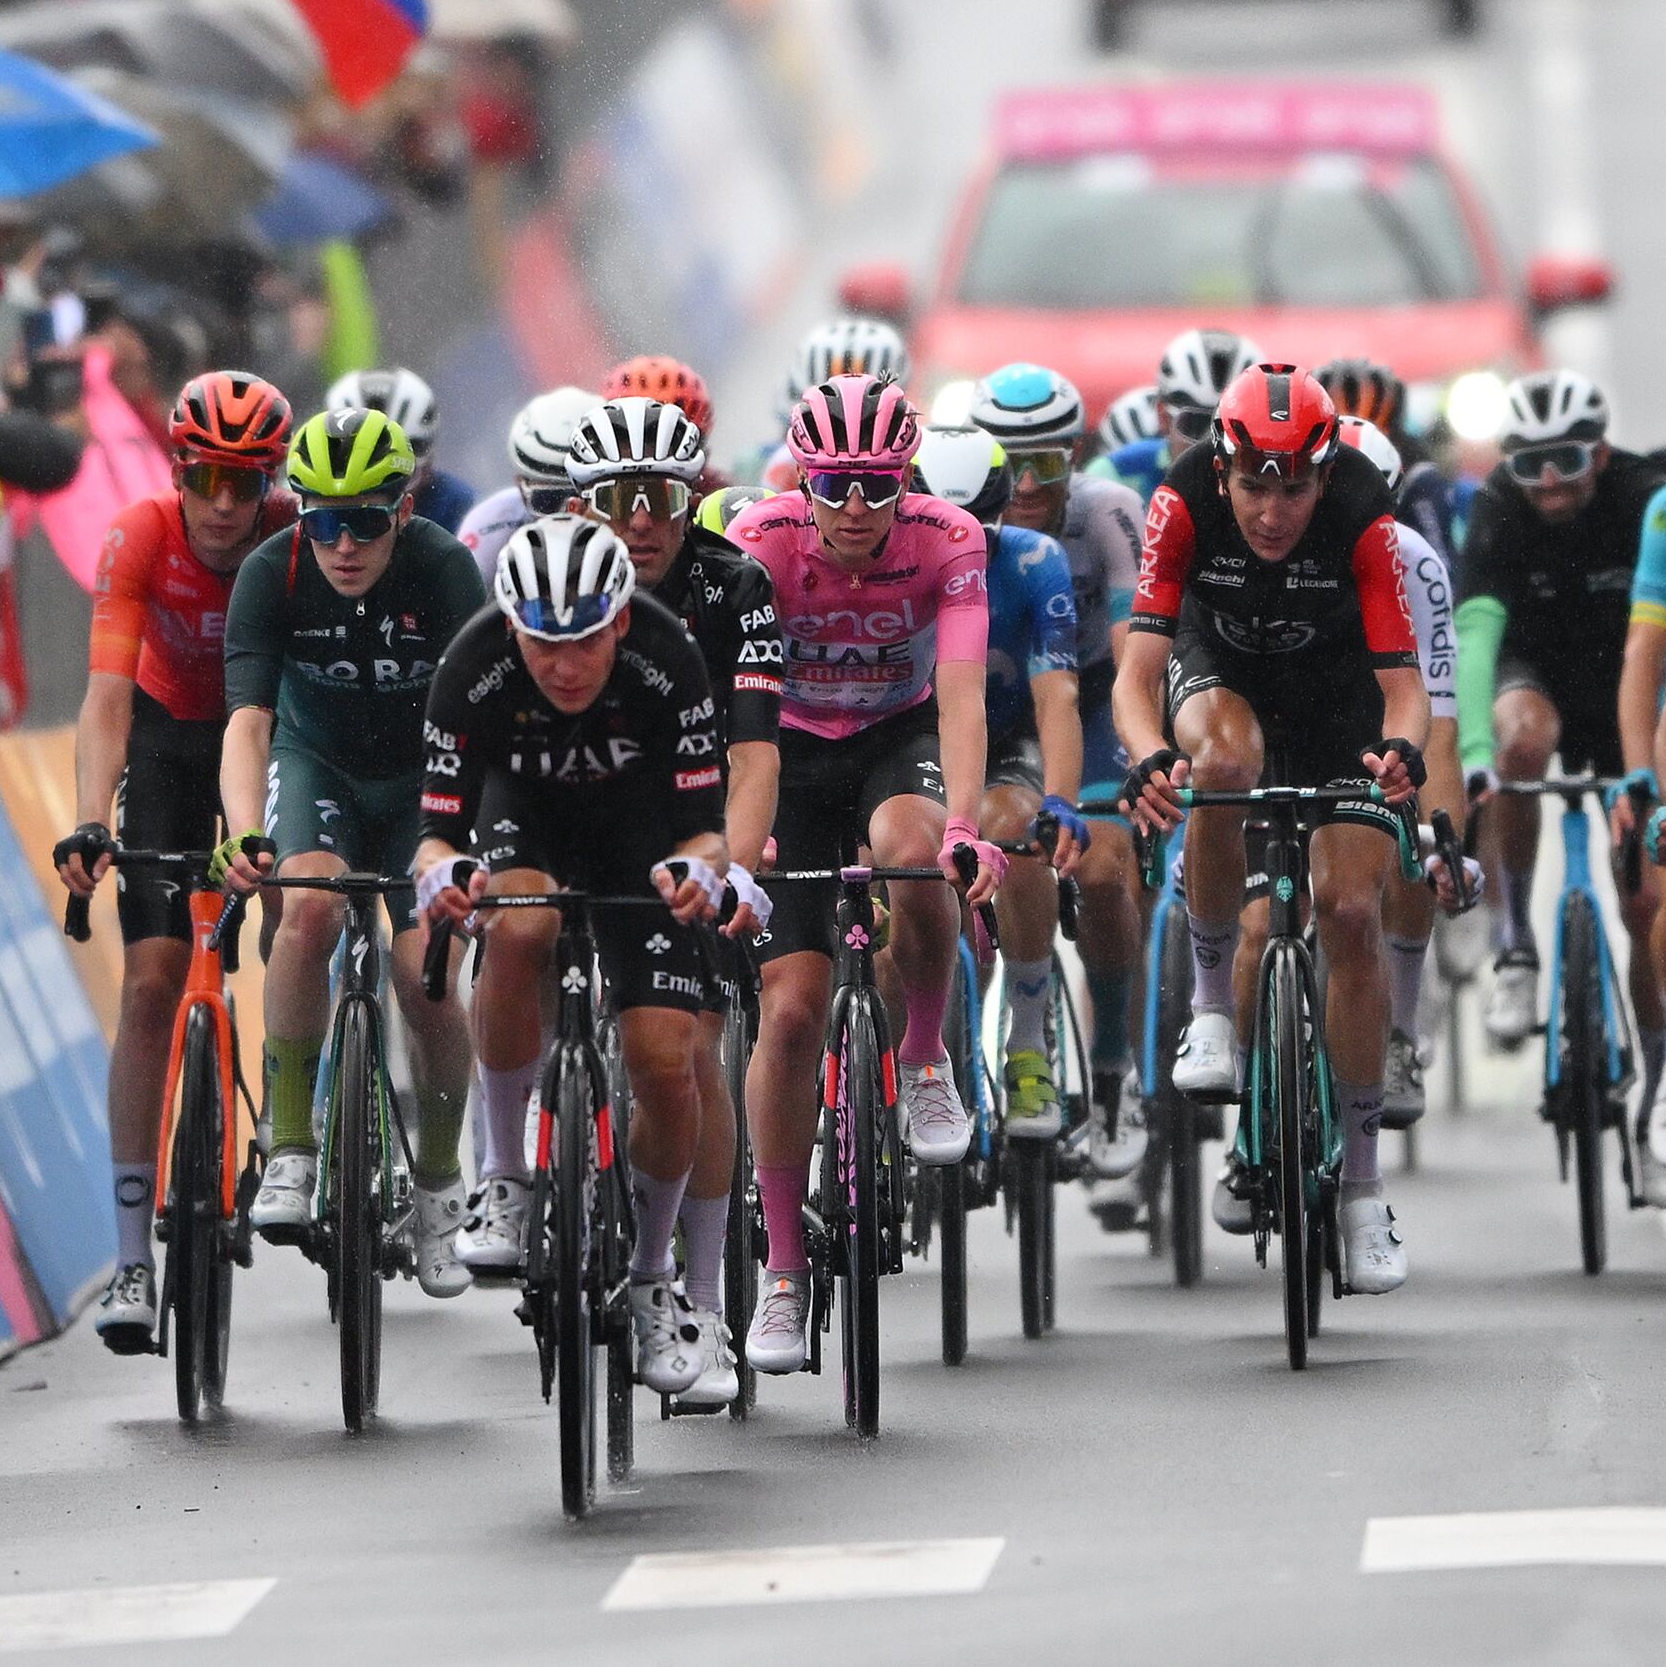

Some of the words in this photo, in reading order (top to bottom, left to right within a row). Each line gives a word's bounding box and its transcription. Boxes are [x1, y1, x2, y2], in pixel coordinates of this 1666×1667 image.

[1137, 490, 1180, 599] ARKEA
[739, 604, 776, 634] FAB
[788, 598, 916, 640] enel
[737, 639, 783, 664] ADQ
[788, 638, 911, 669] UAE
[786, 663, 910, 683] Emirates
[678, 696, 716, 728] FAB
